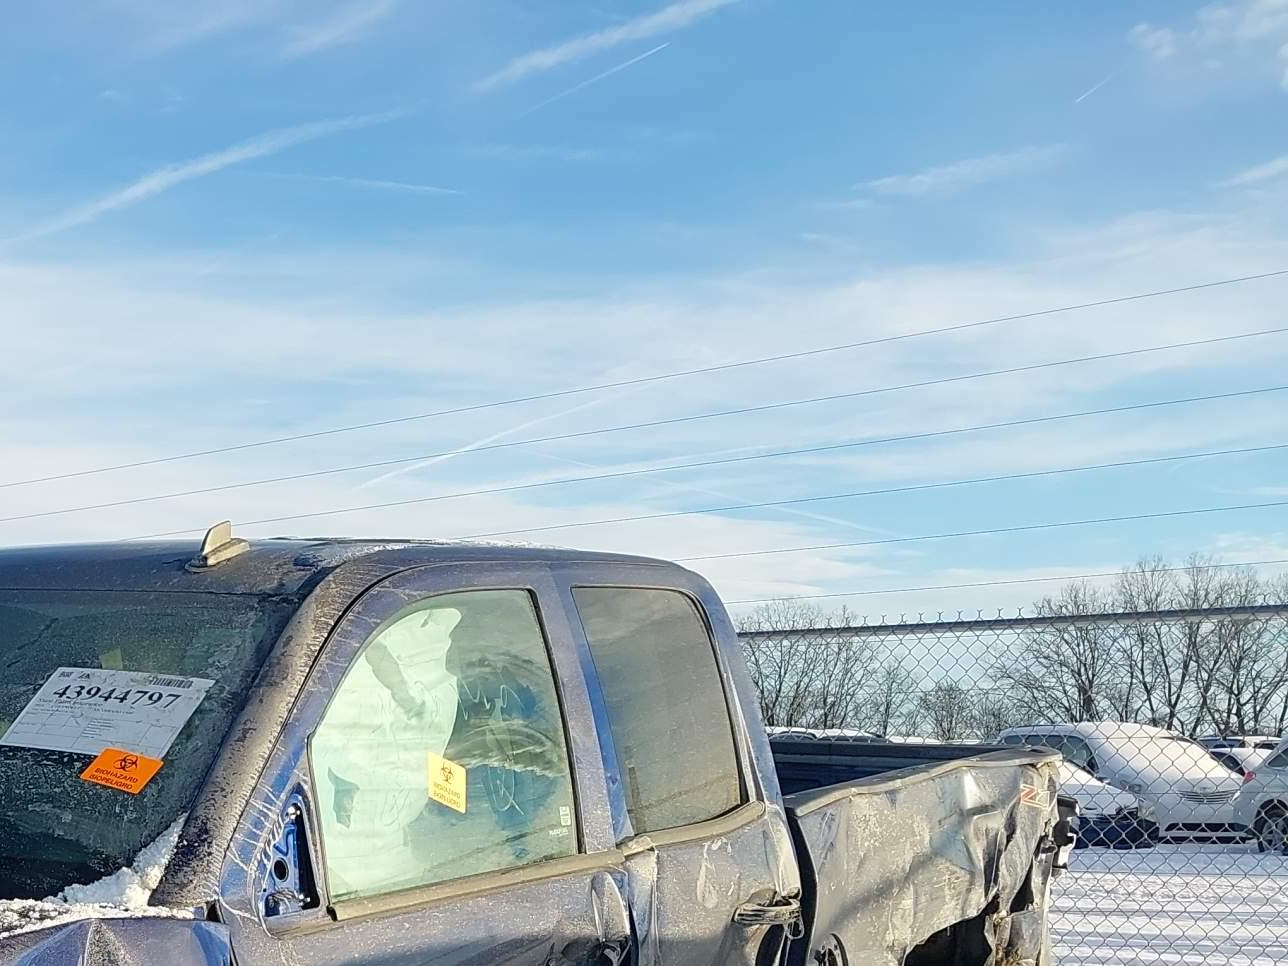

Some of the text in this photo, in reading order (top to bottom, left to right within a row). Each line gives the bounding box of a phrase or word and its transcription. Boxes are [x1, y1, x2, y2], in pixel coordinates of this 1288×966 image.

[52, 684, 183, 709] 43944797
[88, 774, 133, 790] BIOPELIGRO
[94, 767, 138, 784] BIOHAZARD
